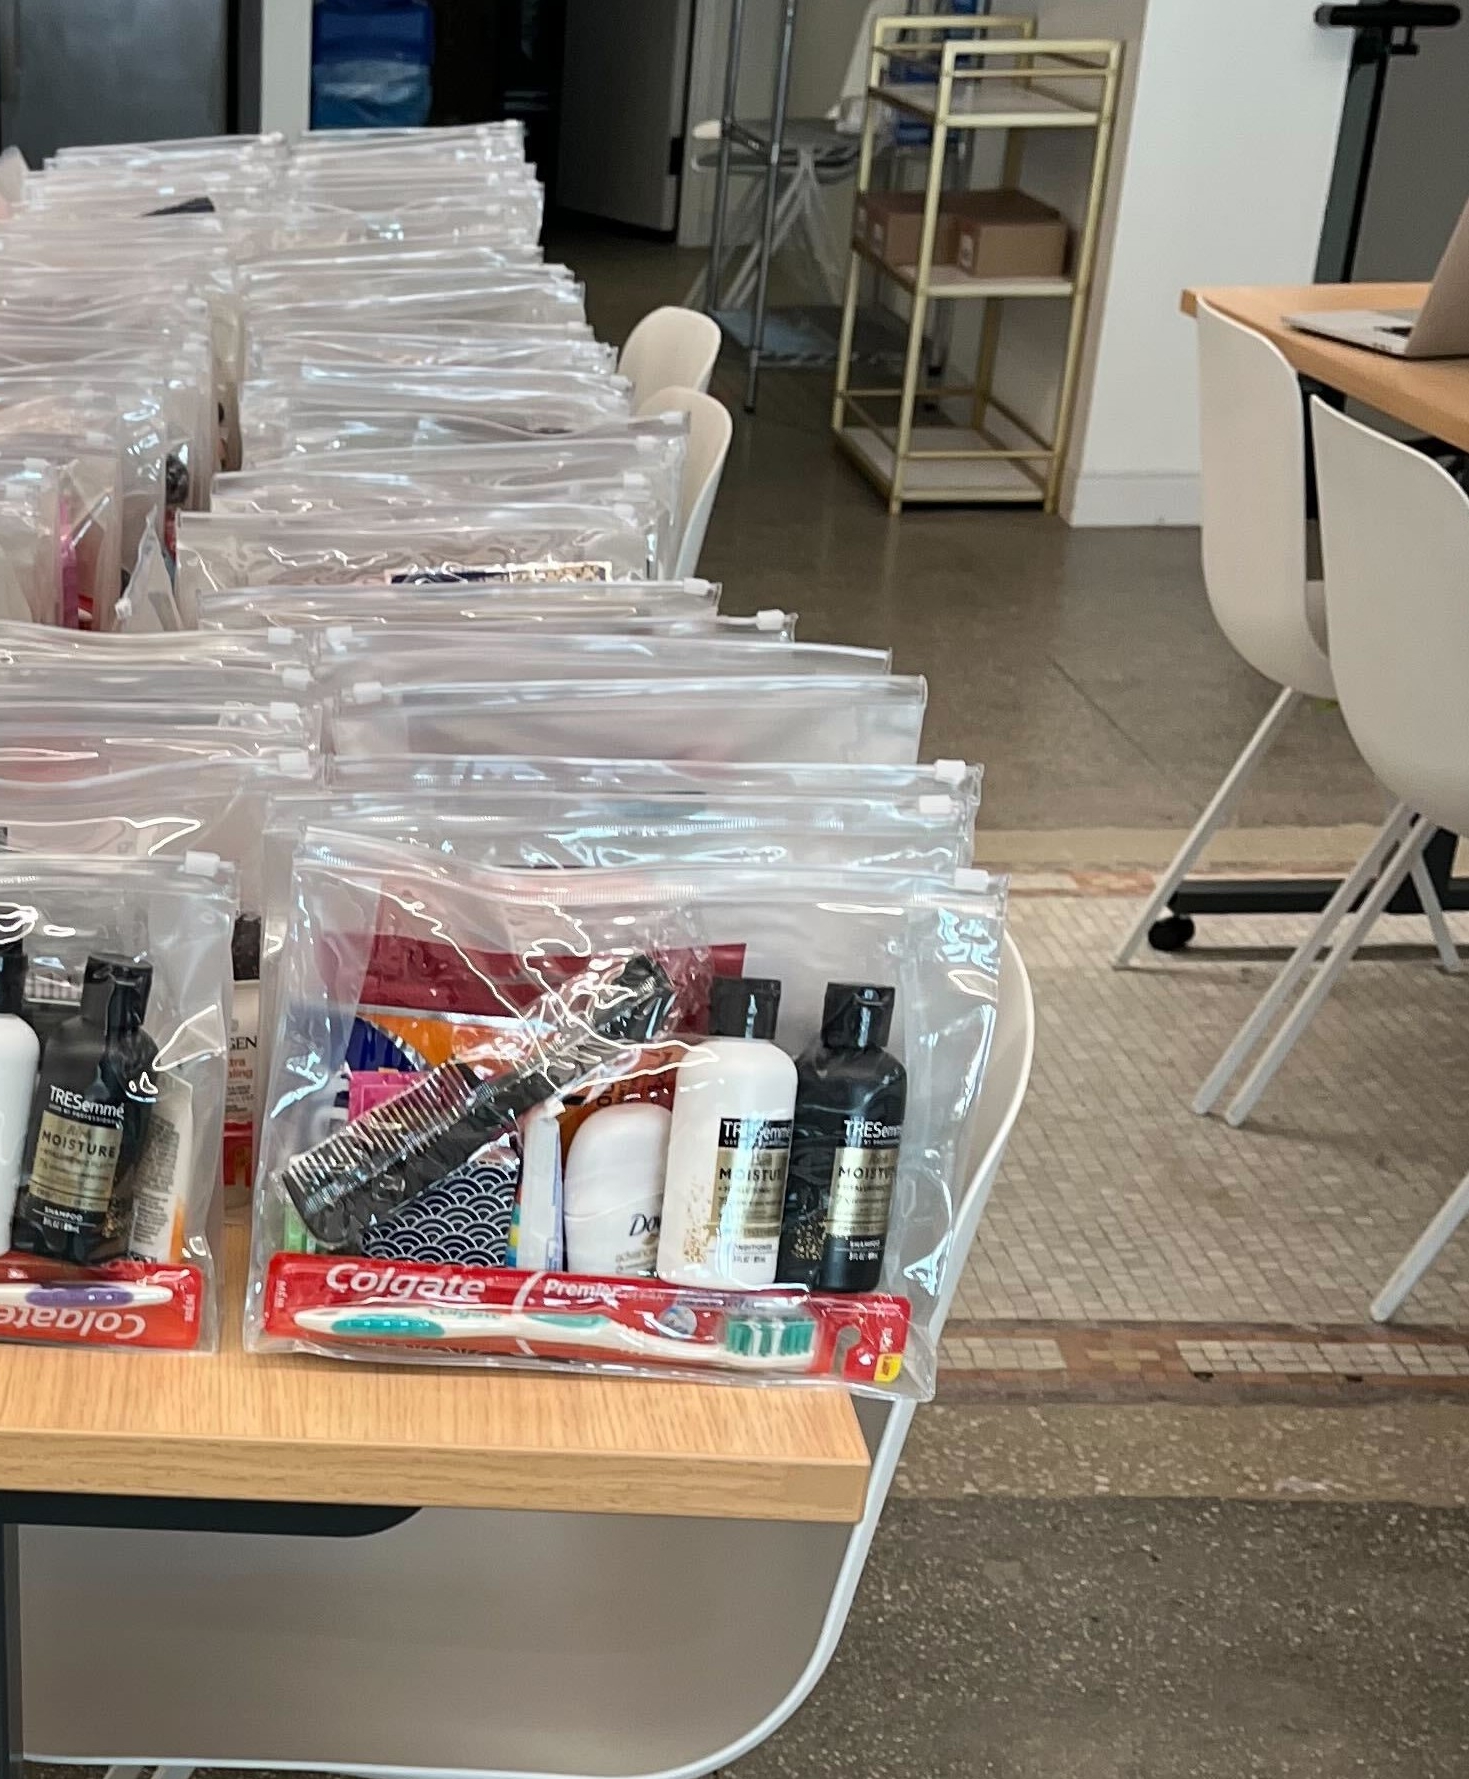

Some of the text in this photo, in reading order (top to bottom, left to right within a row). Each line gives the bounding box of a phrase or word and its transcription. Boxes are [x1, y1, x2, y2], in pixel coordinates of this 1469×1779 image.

[50, 1085, 125, 1121] TRESemmé
[41, 1131, 116, 1158] MOISTURE
[326, 1263, 487, 1299] Colgate
[542, 1278, 620, 1300] Premier
